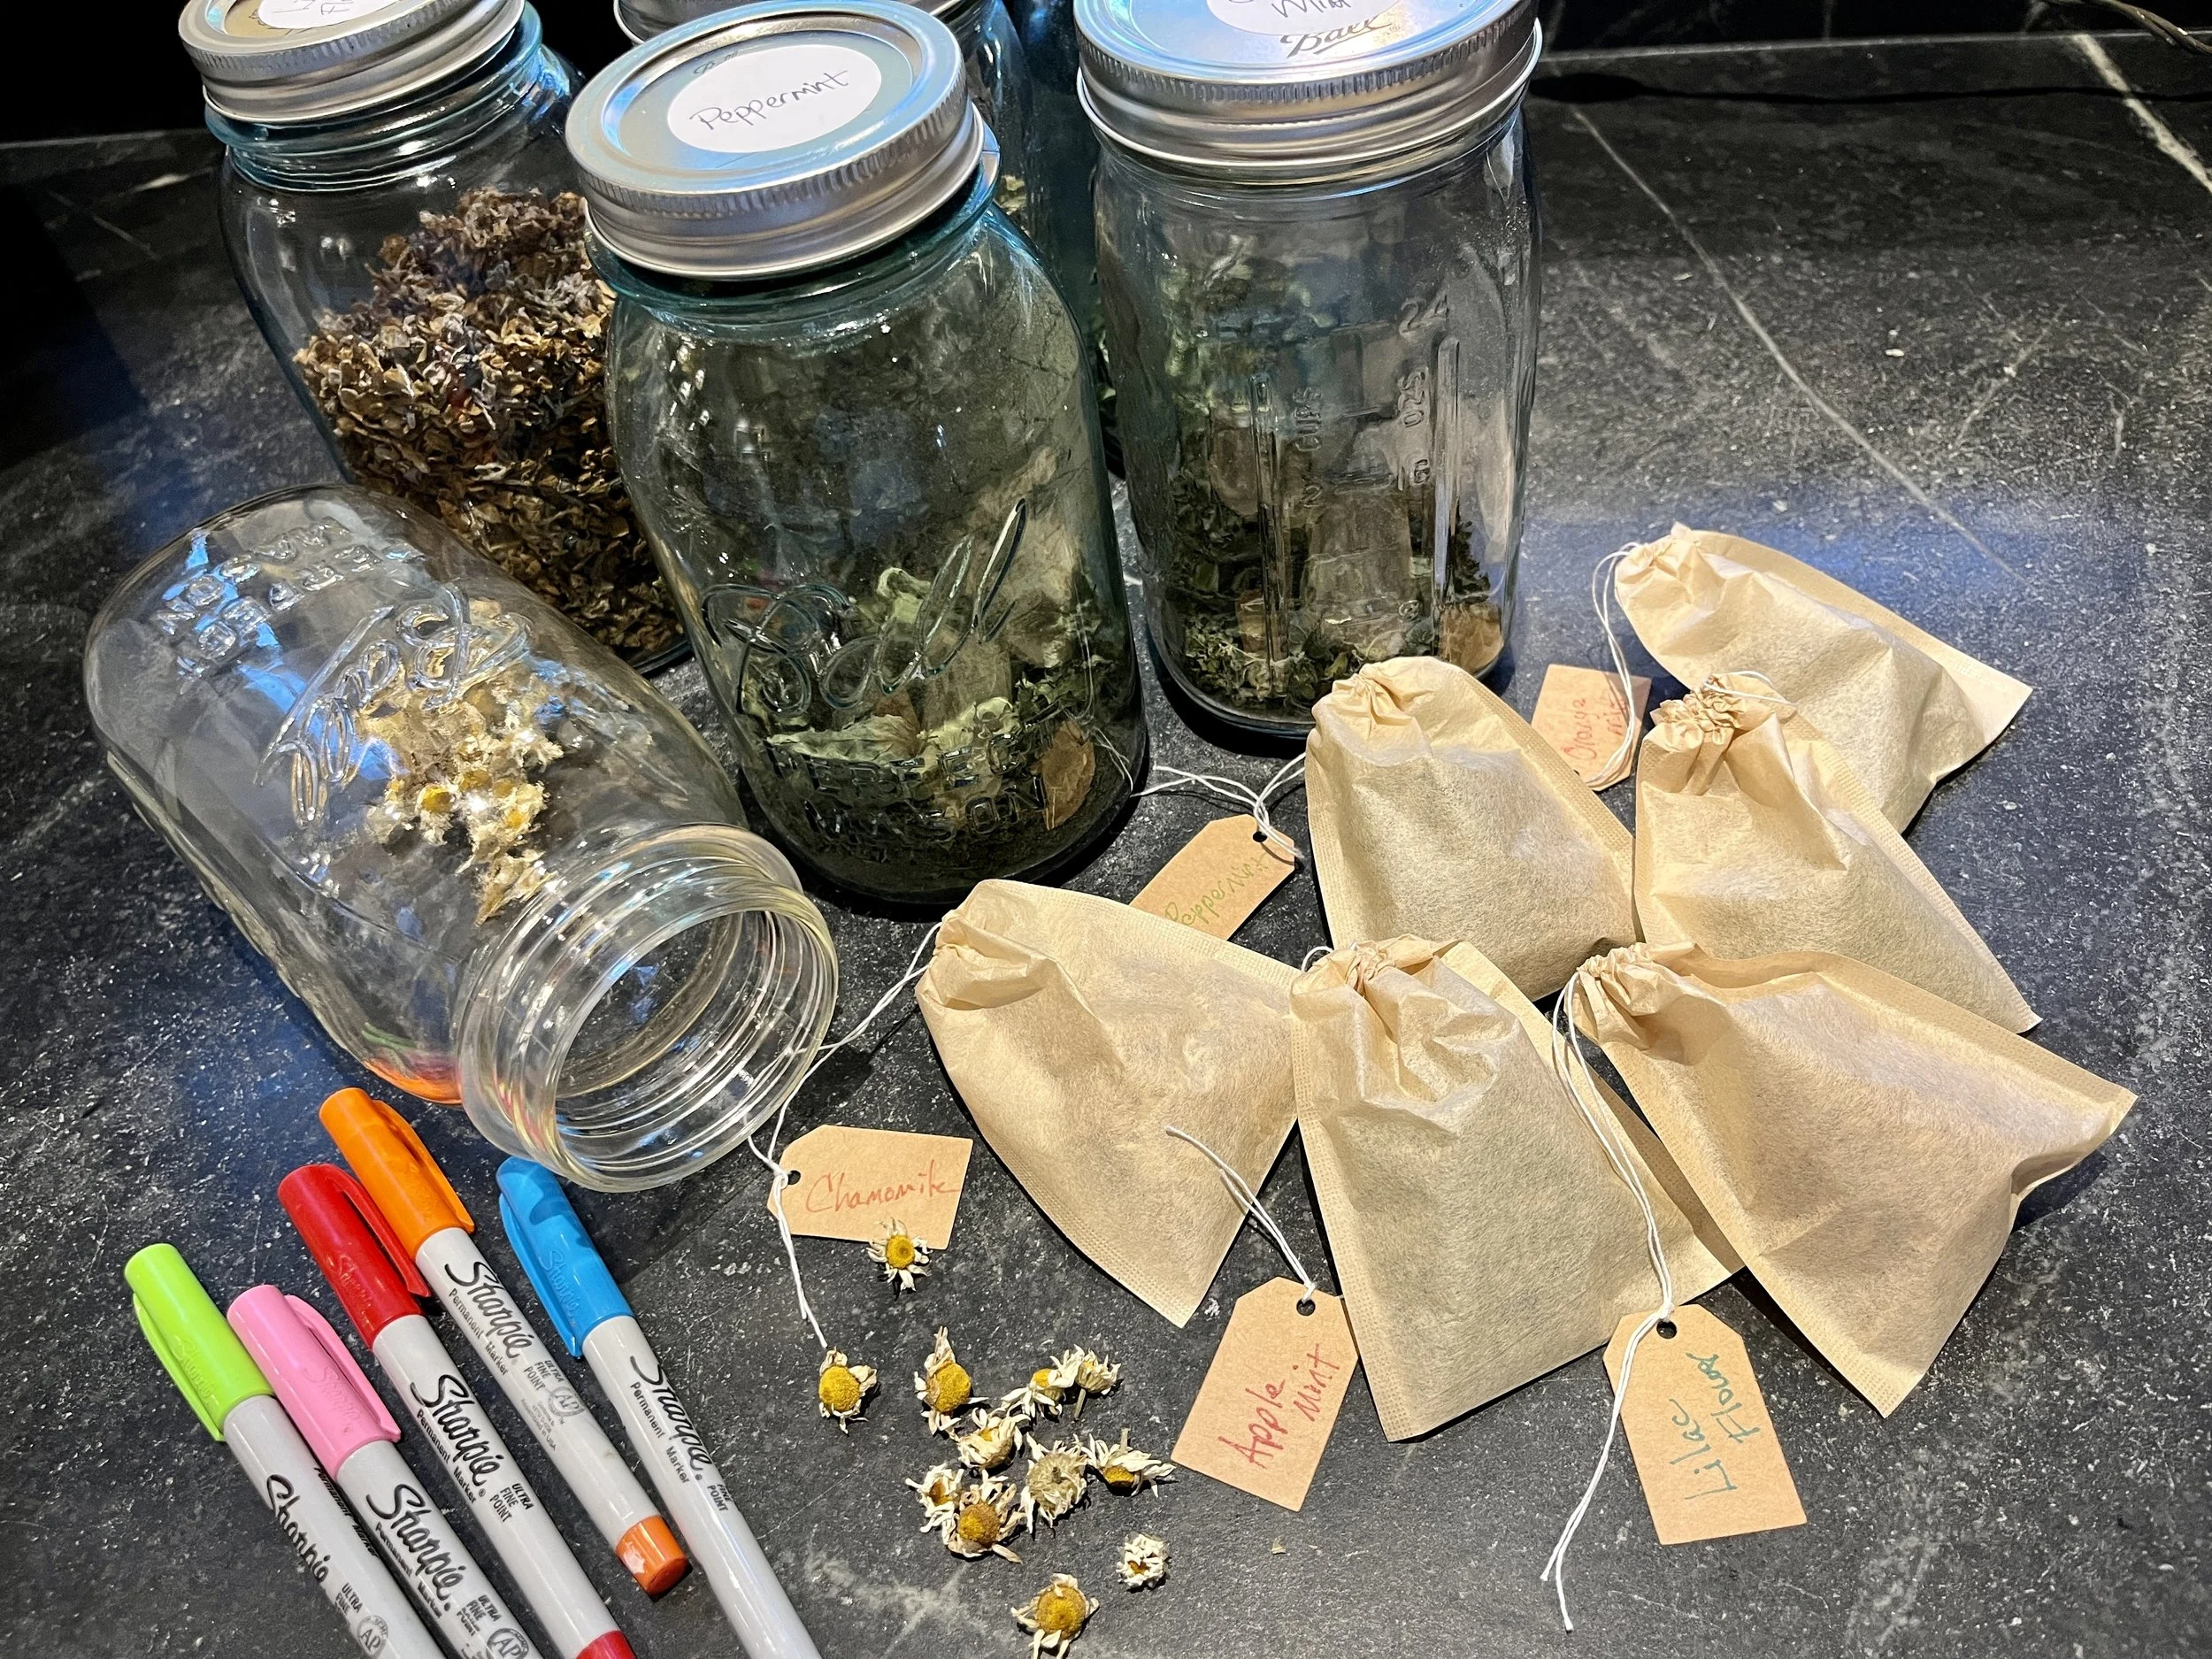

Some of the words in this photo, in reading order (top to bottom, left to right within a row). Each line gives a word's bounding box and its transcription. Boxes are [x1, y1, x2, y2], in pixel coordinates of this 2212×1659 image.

[688, 70, 849, 130] Peppermint
[806, 1159, 961, 1214] Chamomile
[444, 1261, 534, 1359] Sharpie
[449, 1287, 484, 1340] Permanent
[485, 1341, 509, 1375] Marker
[524, 1365, 546, 1391] POINT
[534, 1361, 551, 1379] FINE
[544, 1360, 565, 1382] ULTRA
[1292, 1343, 1340, 1422] Mint
[410, 1374, 504, 1486] Sharpie
[629, 1355, 713, 1471] Sharpie
[630, 1380, 665, 1439] Permanent
[665, 1445, 691, 1484] Marker
[1217, 1379, 1288, 1470] Apple
[417, 1408, 451, 1464] Permanent
[453, 1466, 478, 1504] Marker
[1669, 1398, 1738, 1500] Lilac
[314, 1466, 352, 1517] Permanent
[351, 1524, 380, 1557] Marker
[489, 1494, 512, 1523] POINT
[500, 1486, 519, 1508] FINE
[511, 1482, 534, 1510] ULTRA
[707, 1485, 729, 1512] POINT
[365, 1483, 466, 1601] Sharpie
[342, 1582, 363, 1614] ULTRA
[466, 1599, 486, 1621] FINE
[478, 1594, 502, 1622] ULTRA
